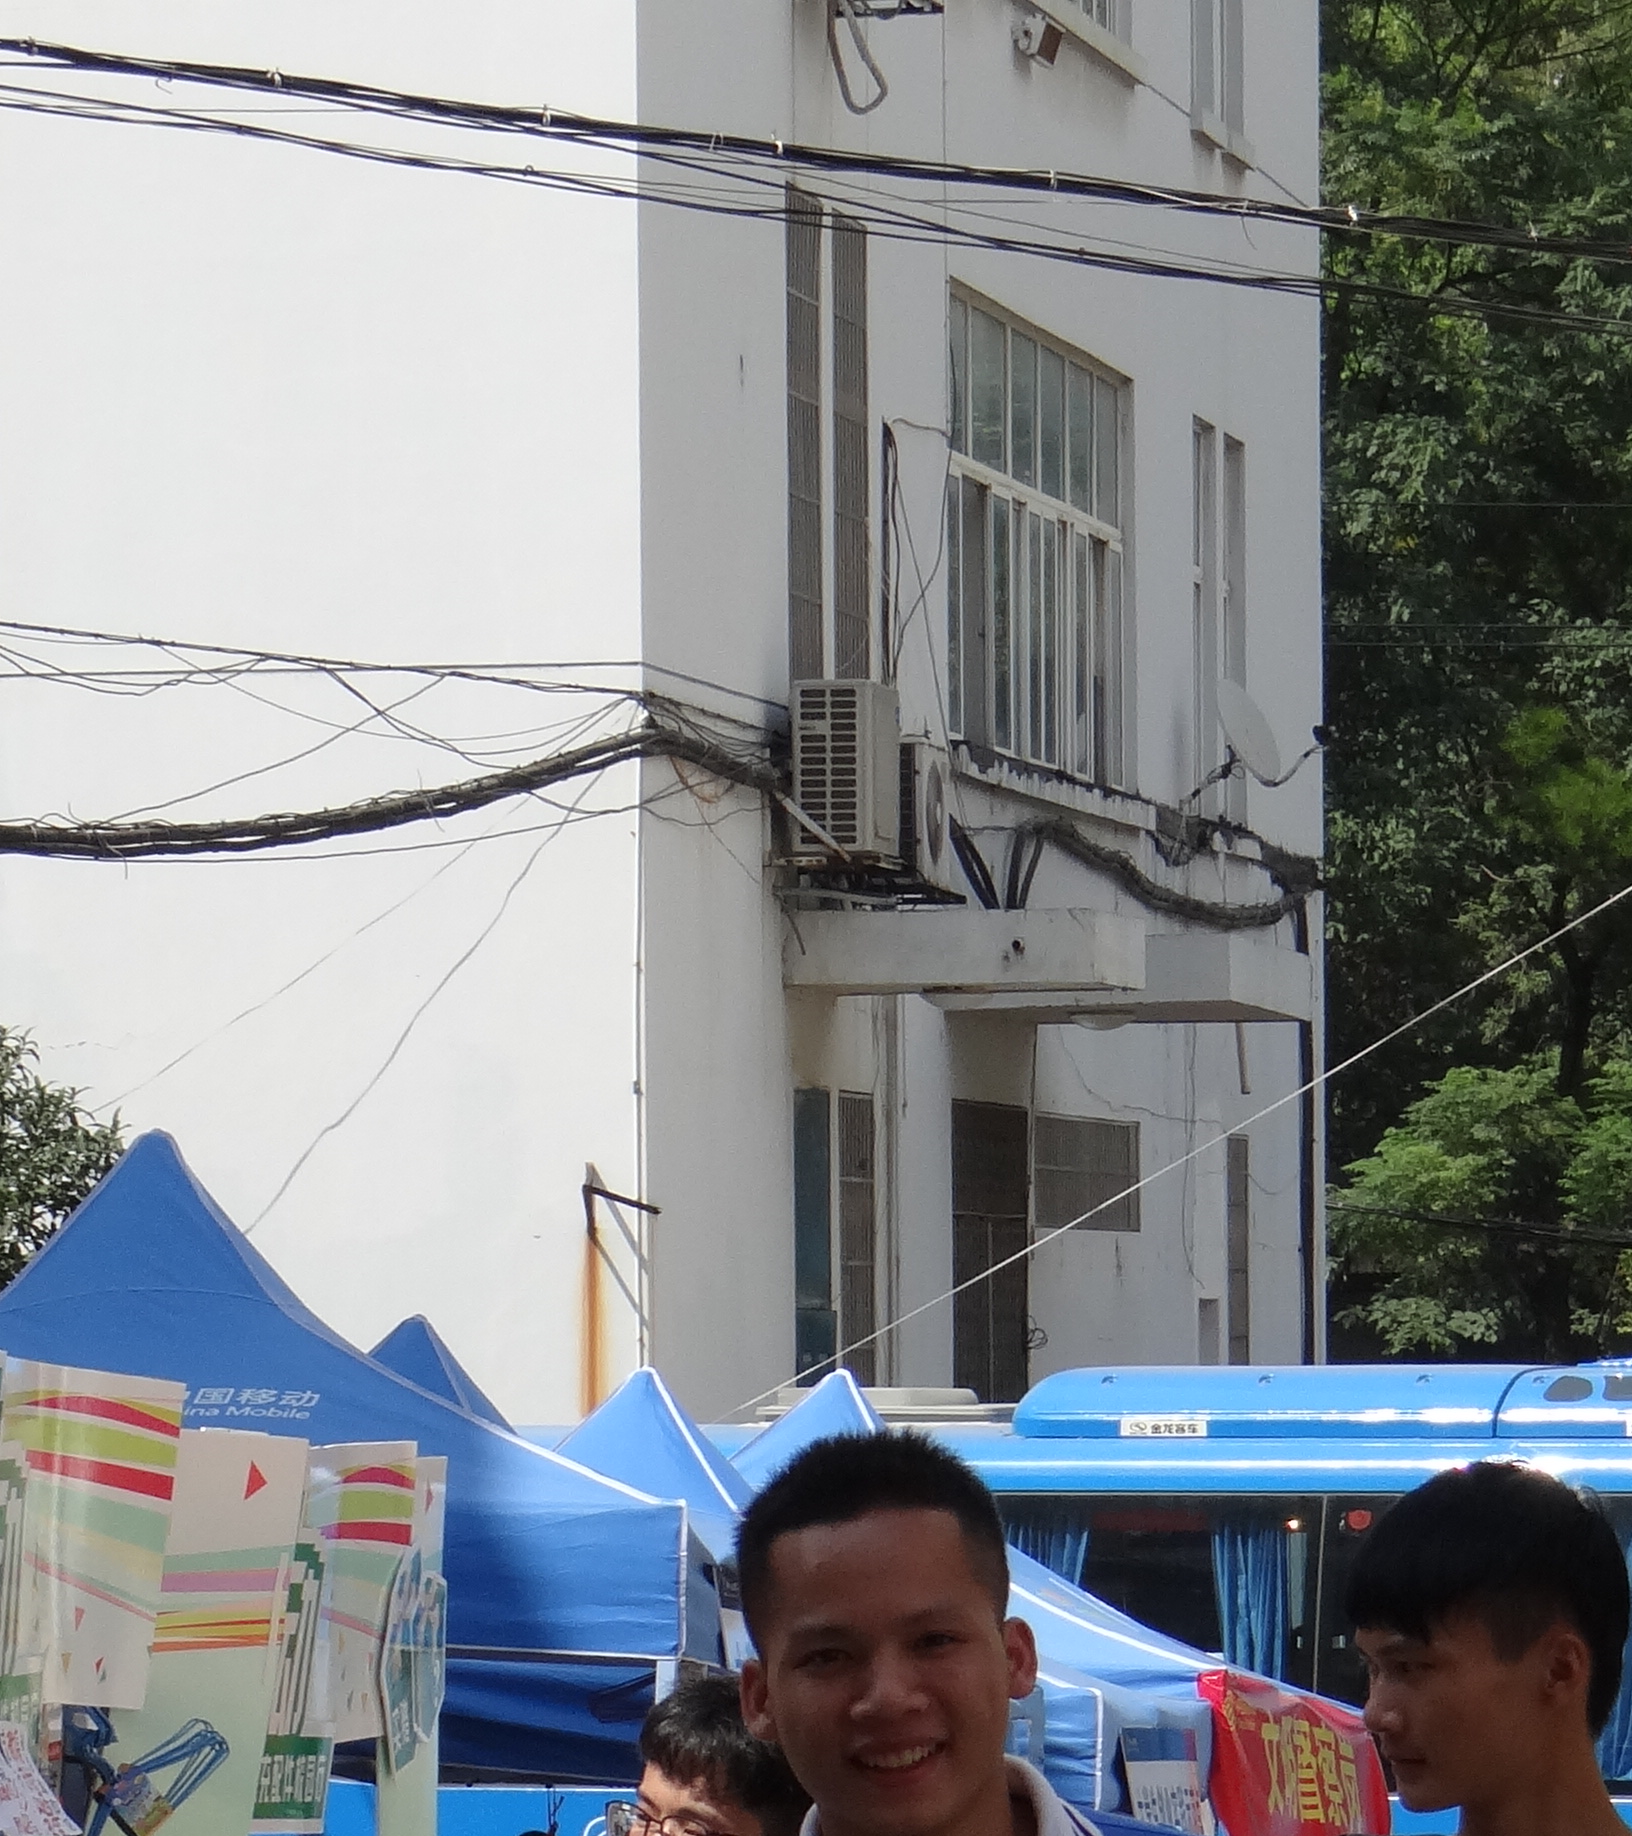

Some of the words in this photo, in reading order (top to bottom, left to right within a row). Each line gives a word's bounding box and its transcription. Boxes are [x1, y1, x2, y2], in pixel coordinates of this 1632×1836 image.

[184, 1387, 320, 1407] 国移动
[225, 1405, 311, 1420] Mobile
[1150, 1422, 1200, 1435] 金龙客车
